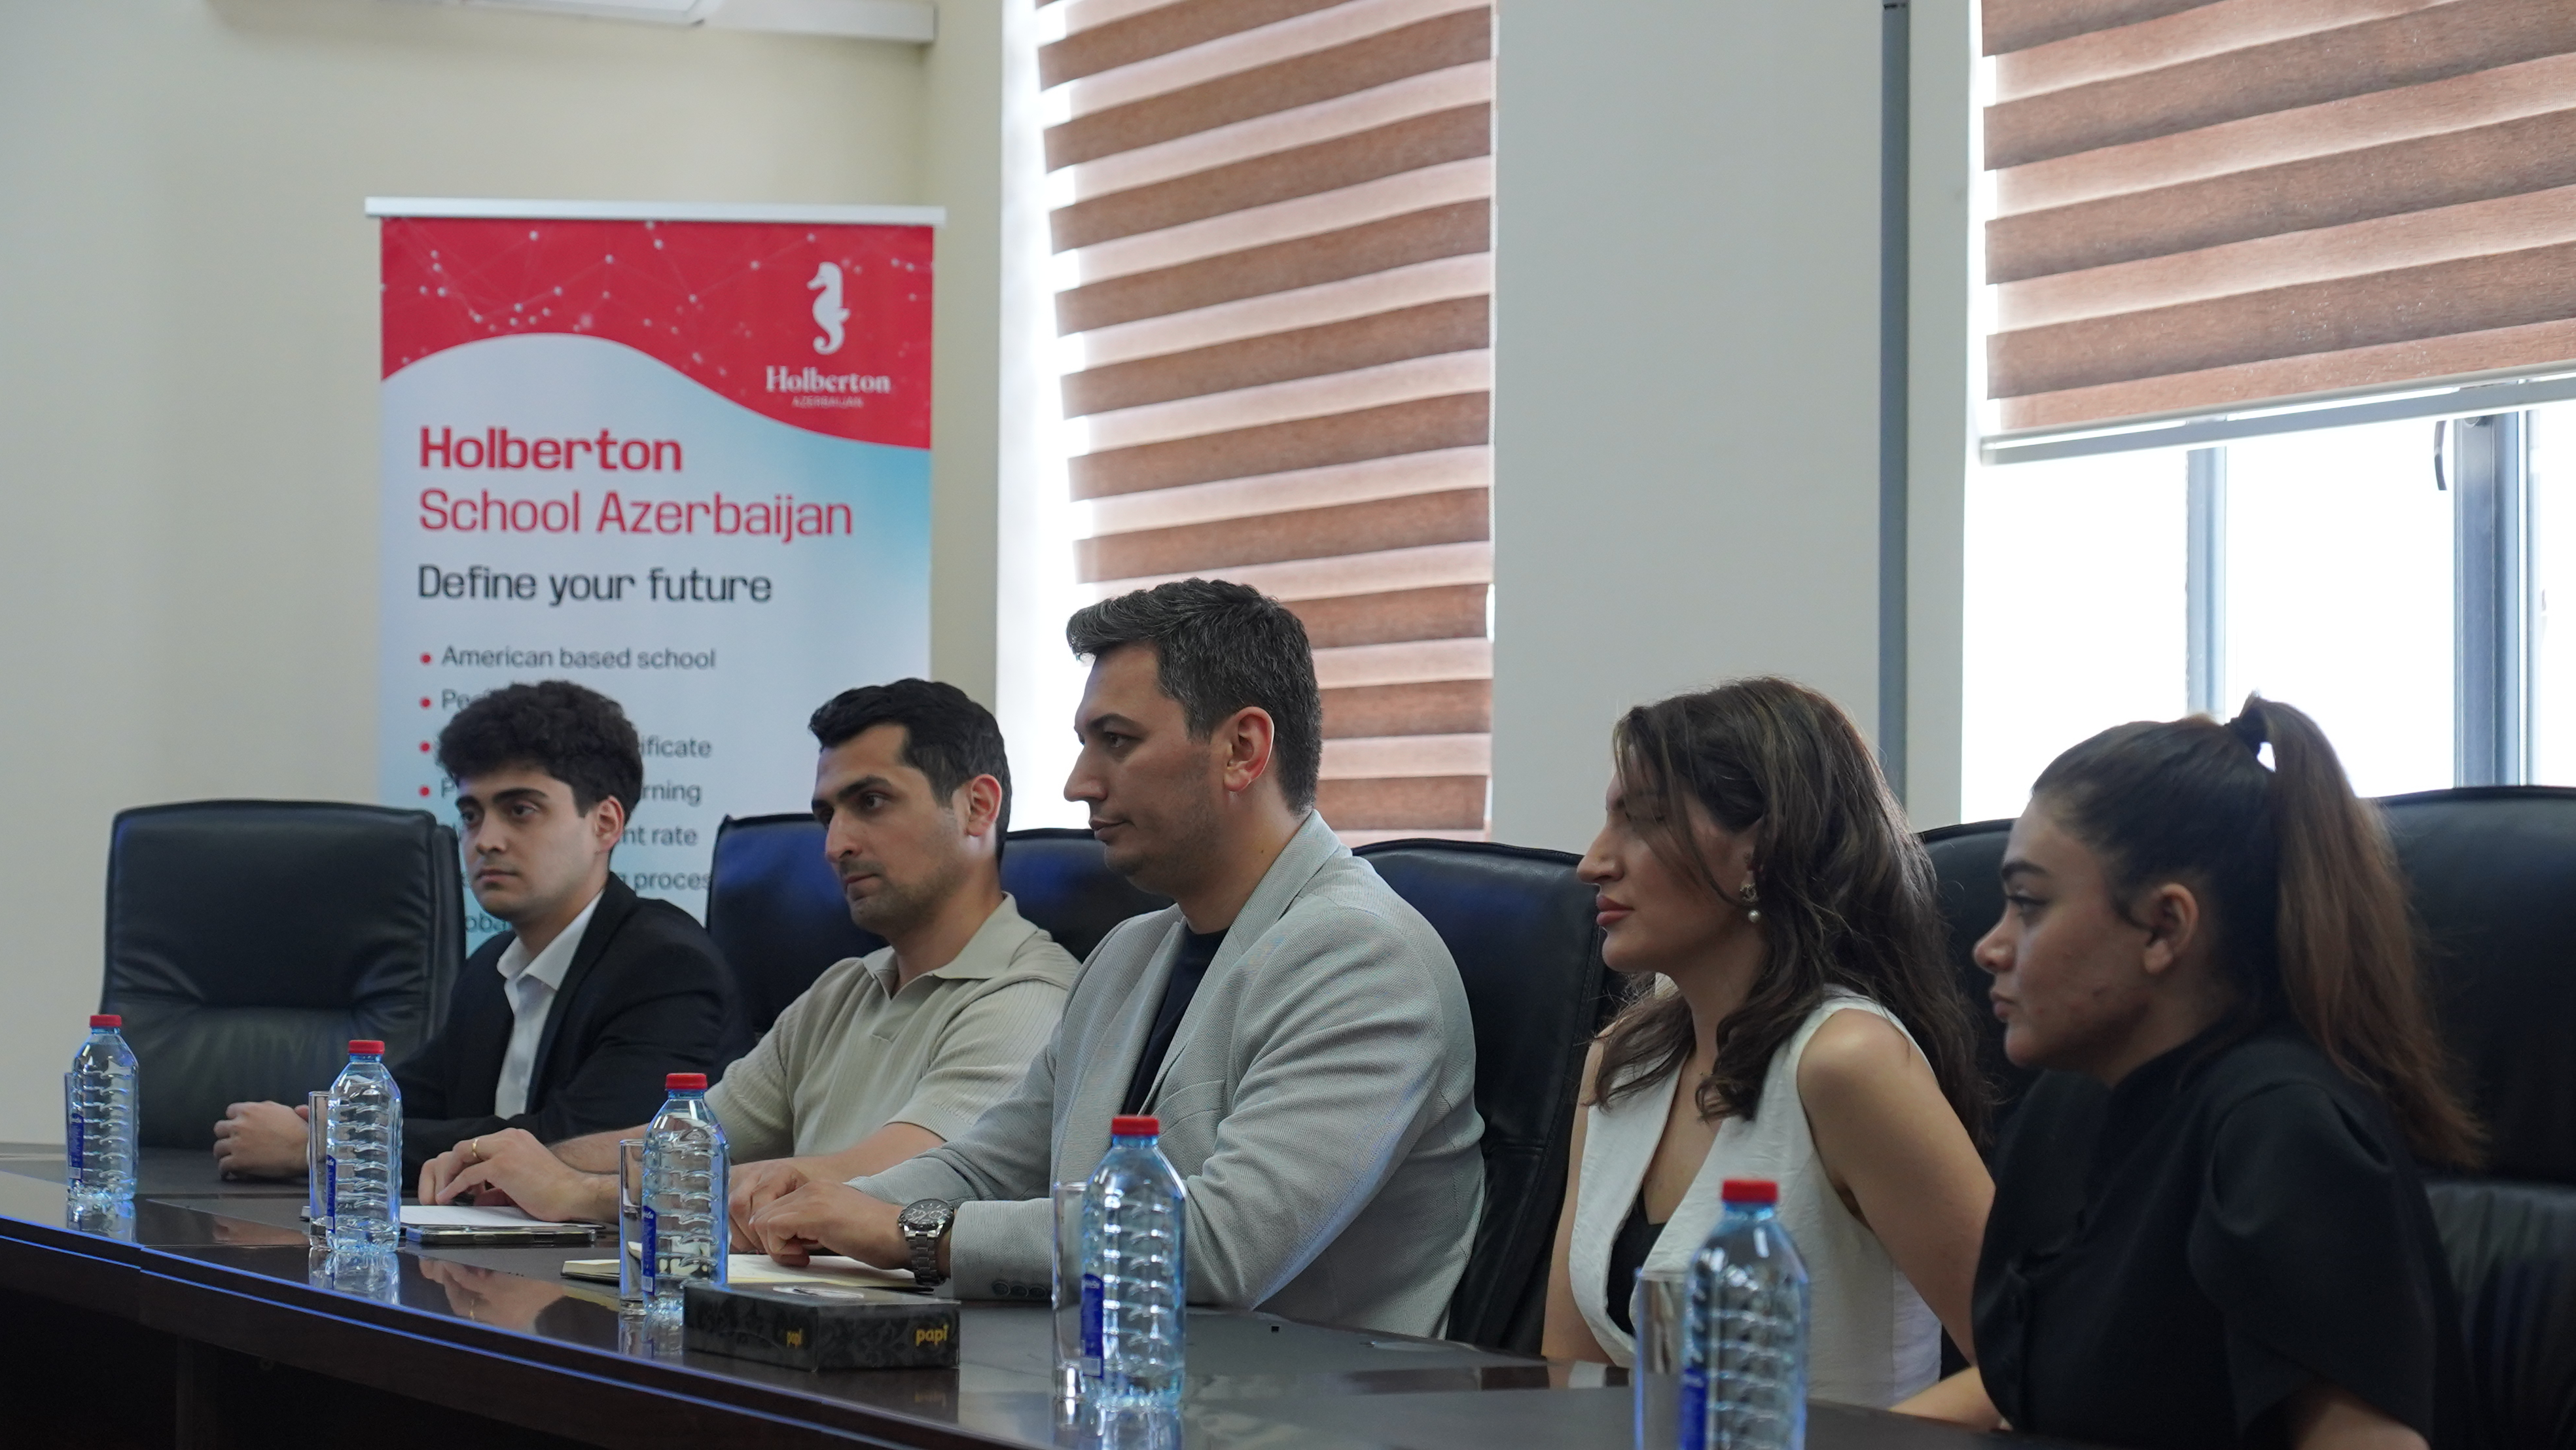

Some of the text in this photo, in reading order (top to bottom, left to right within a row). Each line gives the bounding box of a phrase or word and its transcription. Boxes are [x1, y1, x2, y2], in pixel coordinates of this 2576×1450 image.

[766, 365, 891, 393] Holberton
[420, 426, 682, 471] Holberton
[420, 487, 853, 545] School Azerbaijan
[418, 564, 772, 608] Define your future
[441, 645, 717, 671] American based school
[640, 734, 713, 758] ificate
[641, 780, 702, 807] rning
[651, 825, 698, 846] rate
[916, 1323, 948, 1347] papi
